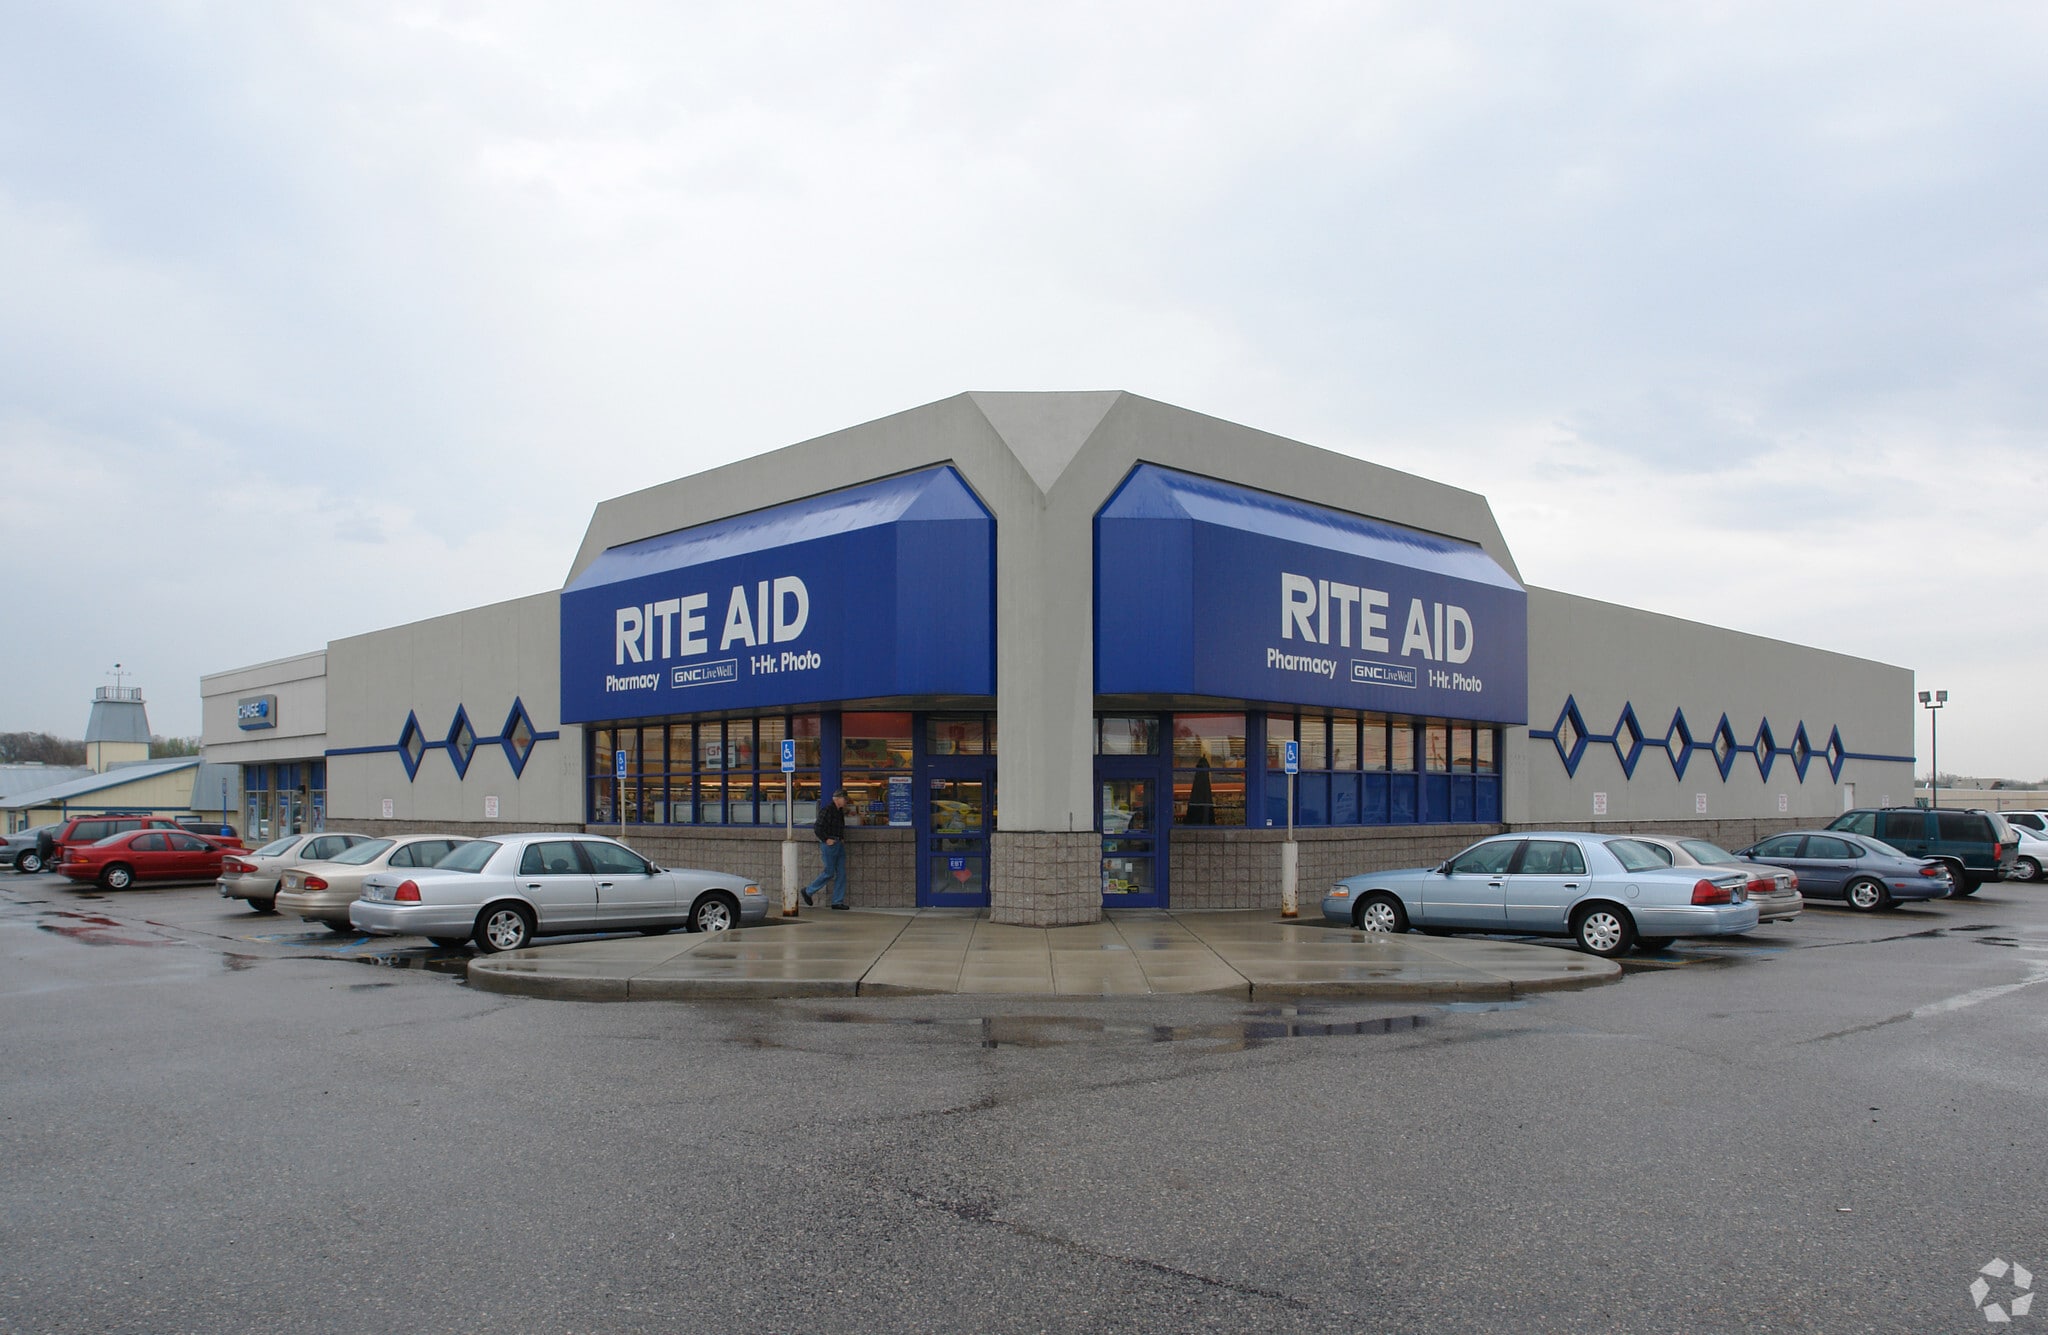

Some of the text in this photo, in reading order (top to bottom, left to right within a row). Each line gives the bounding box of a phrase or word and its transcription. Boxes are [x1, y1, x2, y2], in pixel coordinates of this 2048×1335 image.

[616, 575, 809, 665] RITE AID
[1281, 572, 1474, 664] RITE AID
[751, 650, 821, 675] 1-Hr. Photo
[1267, 648, 1337, 680] Pharmacy
[1354, 665, 1383, 679] GNC
[606, 673, 660, 692] Pharmacy
[675, 670, 701, 682] GNC
[1428, 669, 1482, 693] 1-Hr. Photo
[238, 703, 260, 718] CHASE
